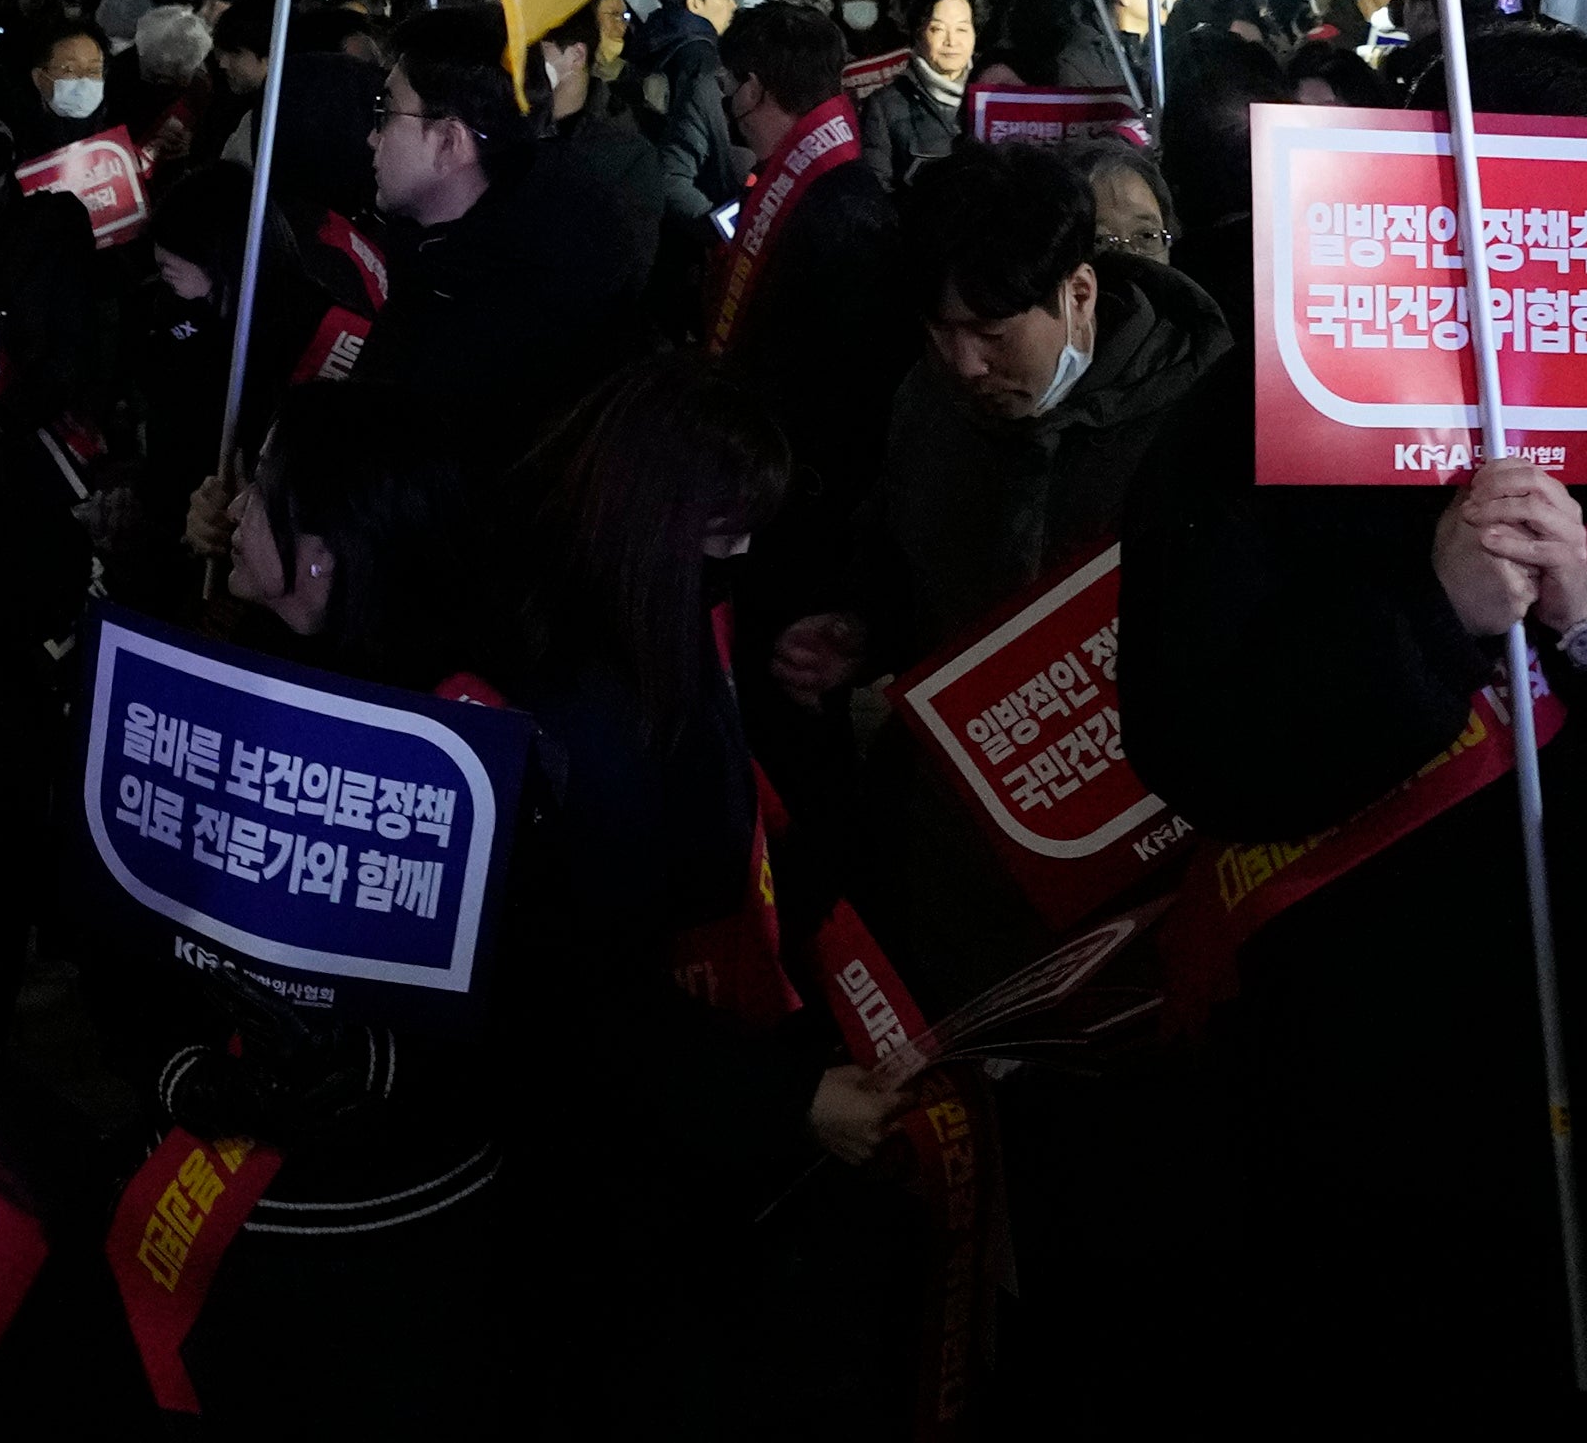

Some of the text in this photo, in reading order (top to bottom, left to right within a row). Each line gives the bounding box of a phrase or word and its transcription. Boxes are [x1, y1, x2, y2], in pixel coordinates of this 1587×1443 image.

[1305, 282, 1472, 351] 국민건강
[1394, 442, 1473, 472] KMA
[963, 647, 1099, 761] 일방적인
[123, 700, 459, 850] 올바른 보건의료정책
[115, 772, 445, 921] 의료 전문가와 함께
[1132, 815, 1197, 864] KMA
